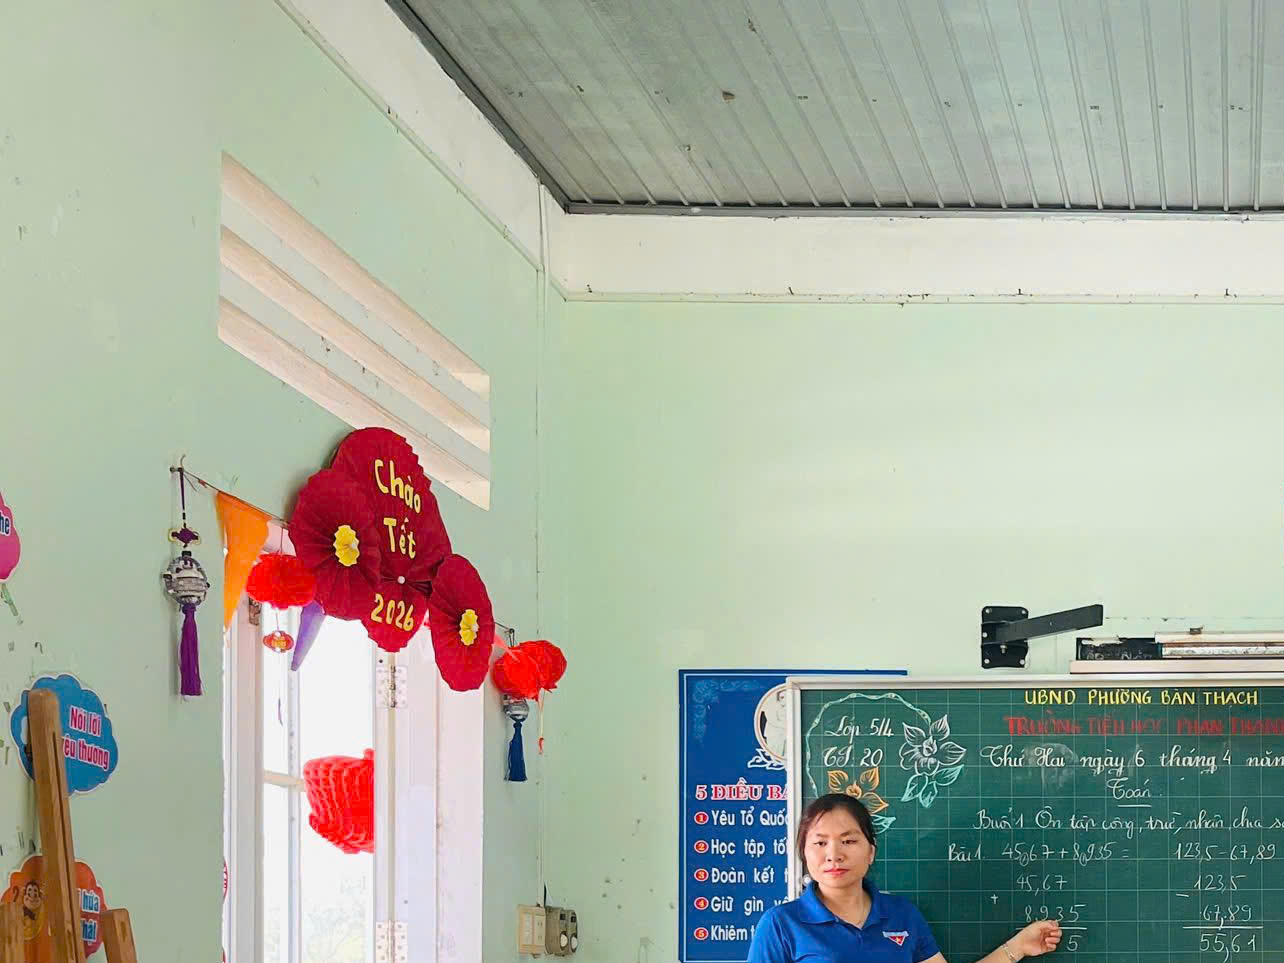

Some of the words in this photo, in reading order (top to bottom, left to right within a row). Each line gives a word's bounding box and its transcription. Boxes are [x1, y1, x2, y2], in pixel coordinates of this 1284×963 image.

[374, 458, 422, 514] Chào
[384, 516, 416, 560] Tết
[370, 593, 415, 632] 2026
[1024, 689, 1076, 705] UBND
[870, 717, 895, 738] 5/4
[860, 747, 884, 767] 20
[980, 744, 1025, 767] Thứ
[1080, 749, 1125, 776] ngày
[1134, 749, 1146, 767] 6
[1160, 744, 1217, 774] tháng
[1222, 749, 1232, 765] 4
[695, 784, 707, 800] 5
[711, 776, 764, 801] ĐIỀU
[1106, 777, 1152, 799] Toán
[711, 809, 735, 826] Yêu
[740, 805, 754, 826] Tổ
[1035, 805, 1061, 828] Ôn
[1233, 806, 1263, 829] chia
[711, 838, 736, 859] Học
[744, 838, 765, 858] tập
[711, 866, 745, 884] Đoàn
[753, 865, 775, 884] kết
[1016, 874, 1068, 896] 45,67
[1194, 873, 1248, 894] 123,5
[710, 895, 734, 912] Giữ
[743, 898, 764, 917] gìn
[710, 924, 748, 941] Khiêm
[1066, 934, 1083, 952] 5
[1200, 933, 1257, 963] 55,61
